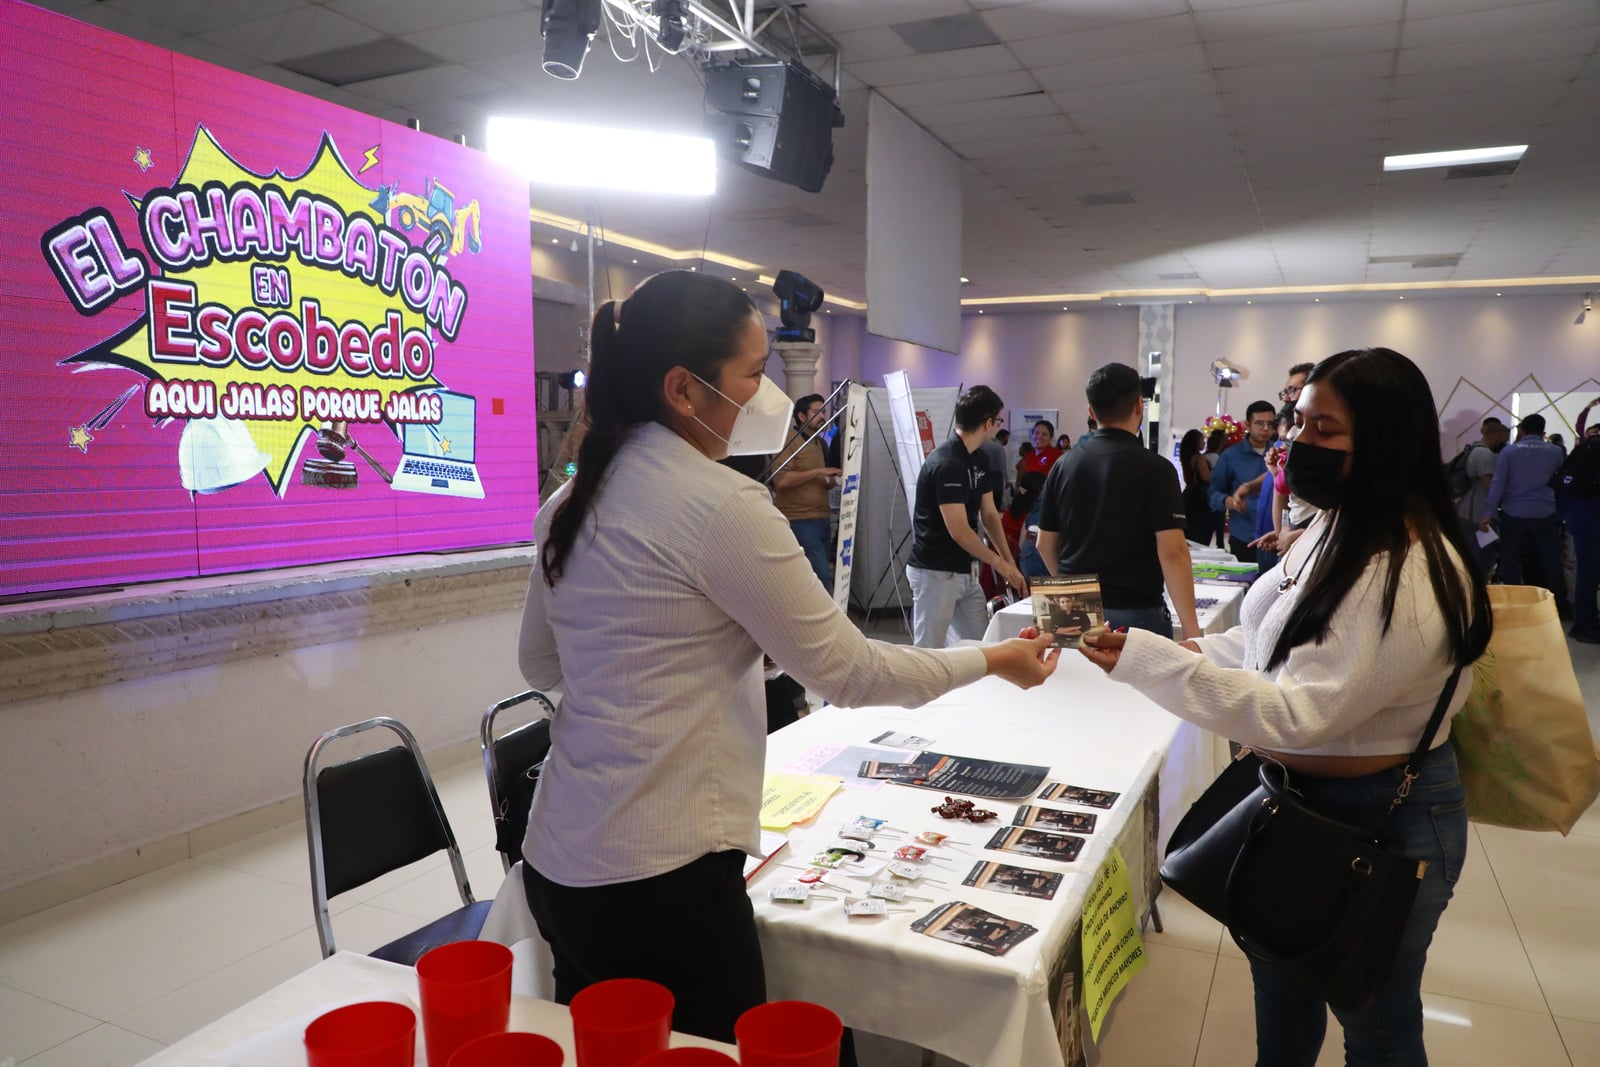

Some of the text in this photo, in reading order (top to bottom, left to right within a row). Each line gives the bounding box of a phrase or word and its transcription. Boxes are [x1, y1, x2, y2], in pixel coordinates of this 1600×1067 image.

[46, 187, 466, 340] EL CHAMBATÓN
[253, 266, 291, 306] EN
[149, 280, 434, 380] Escobedo
[148, 382, 442, 424] AQUI JALAS PORQUE JALAS
[1119, 946, 1143, 976] MAYORES
